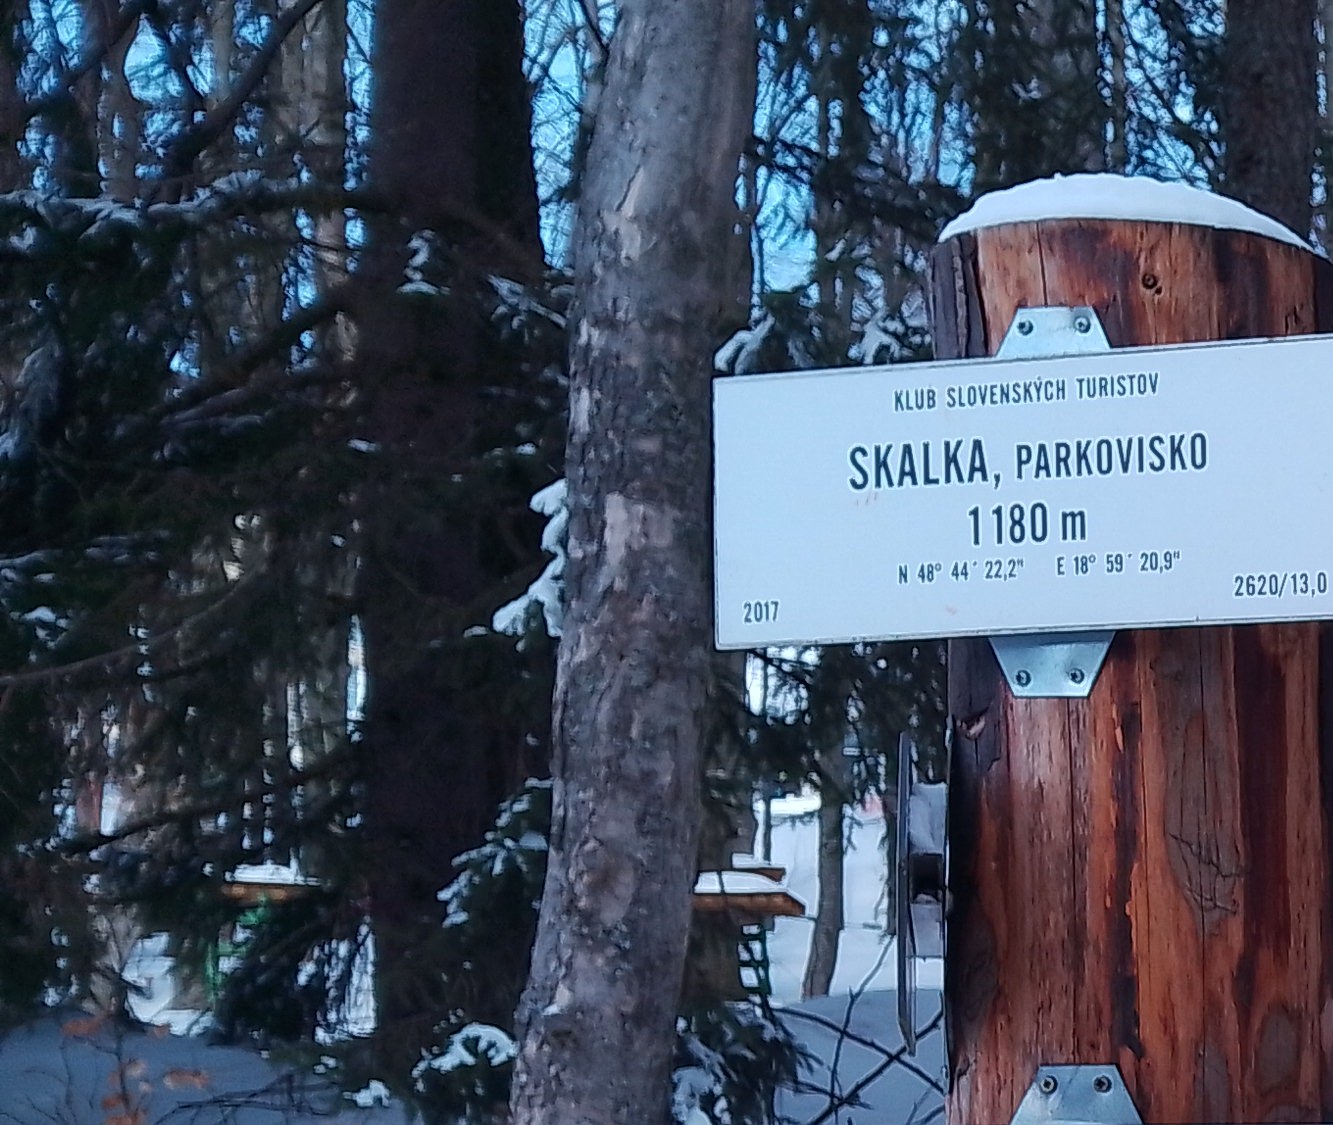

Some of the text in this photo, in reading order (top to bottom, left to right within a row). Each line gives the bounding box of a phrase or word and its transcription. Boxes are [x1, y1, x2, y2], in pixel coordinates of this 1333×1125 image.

[894, 372, 1159, 412] KLUB SLOVENSKÝCH TURISTOV
[849, 432, 1207, 491] SKALKA, PARKOVISKO
[968, 502, 1086, 546] 1180 m
[898, 564, 908, 585] N
[1056, 556, 1066, 576] E
[1234, 571, 1328, 599] 2620/13,0
[743, 600, 780, 624] 2017
